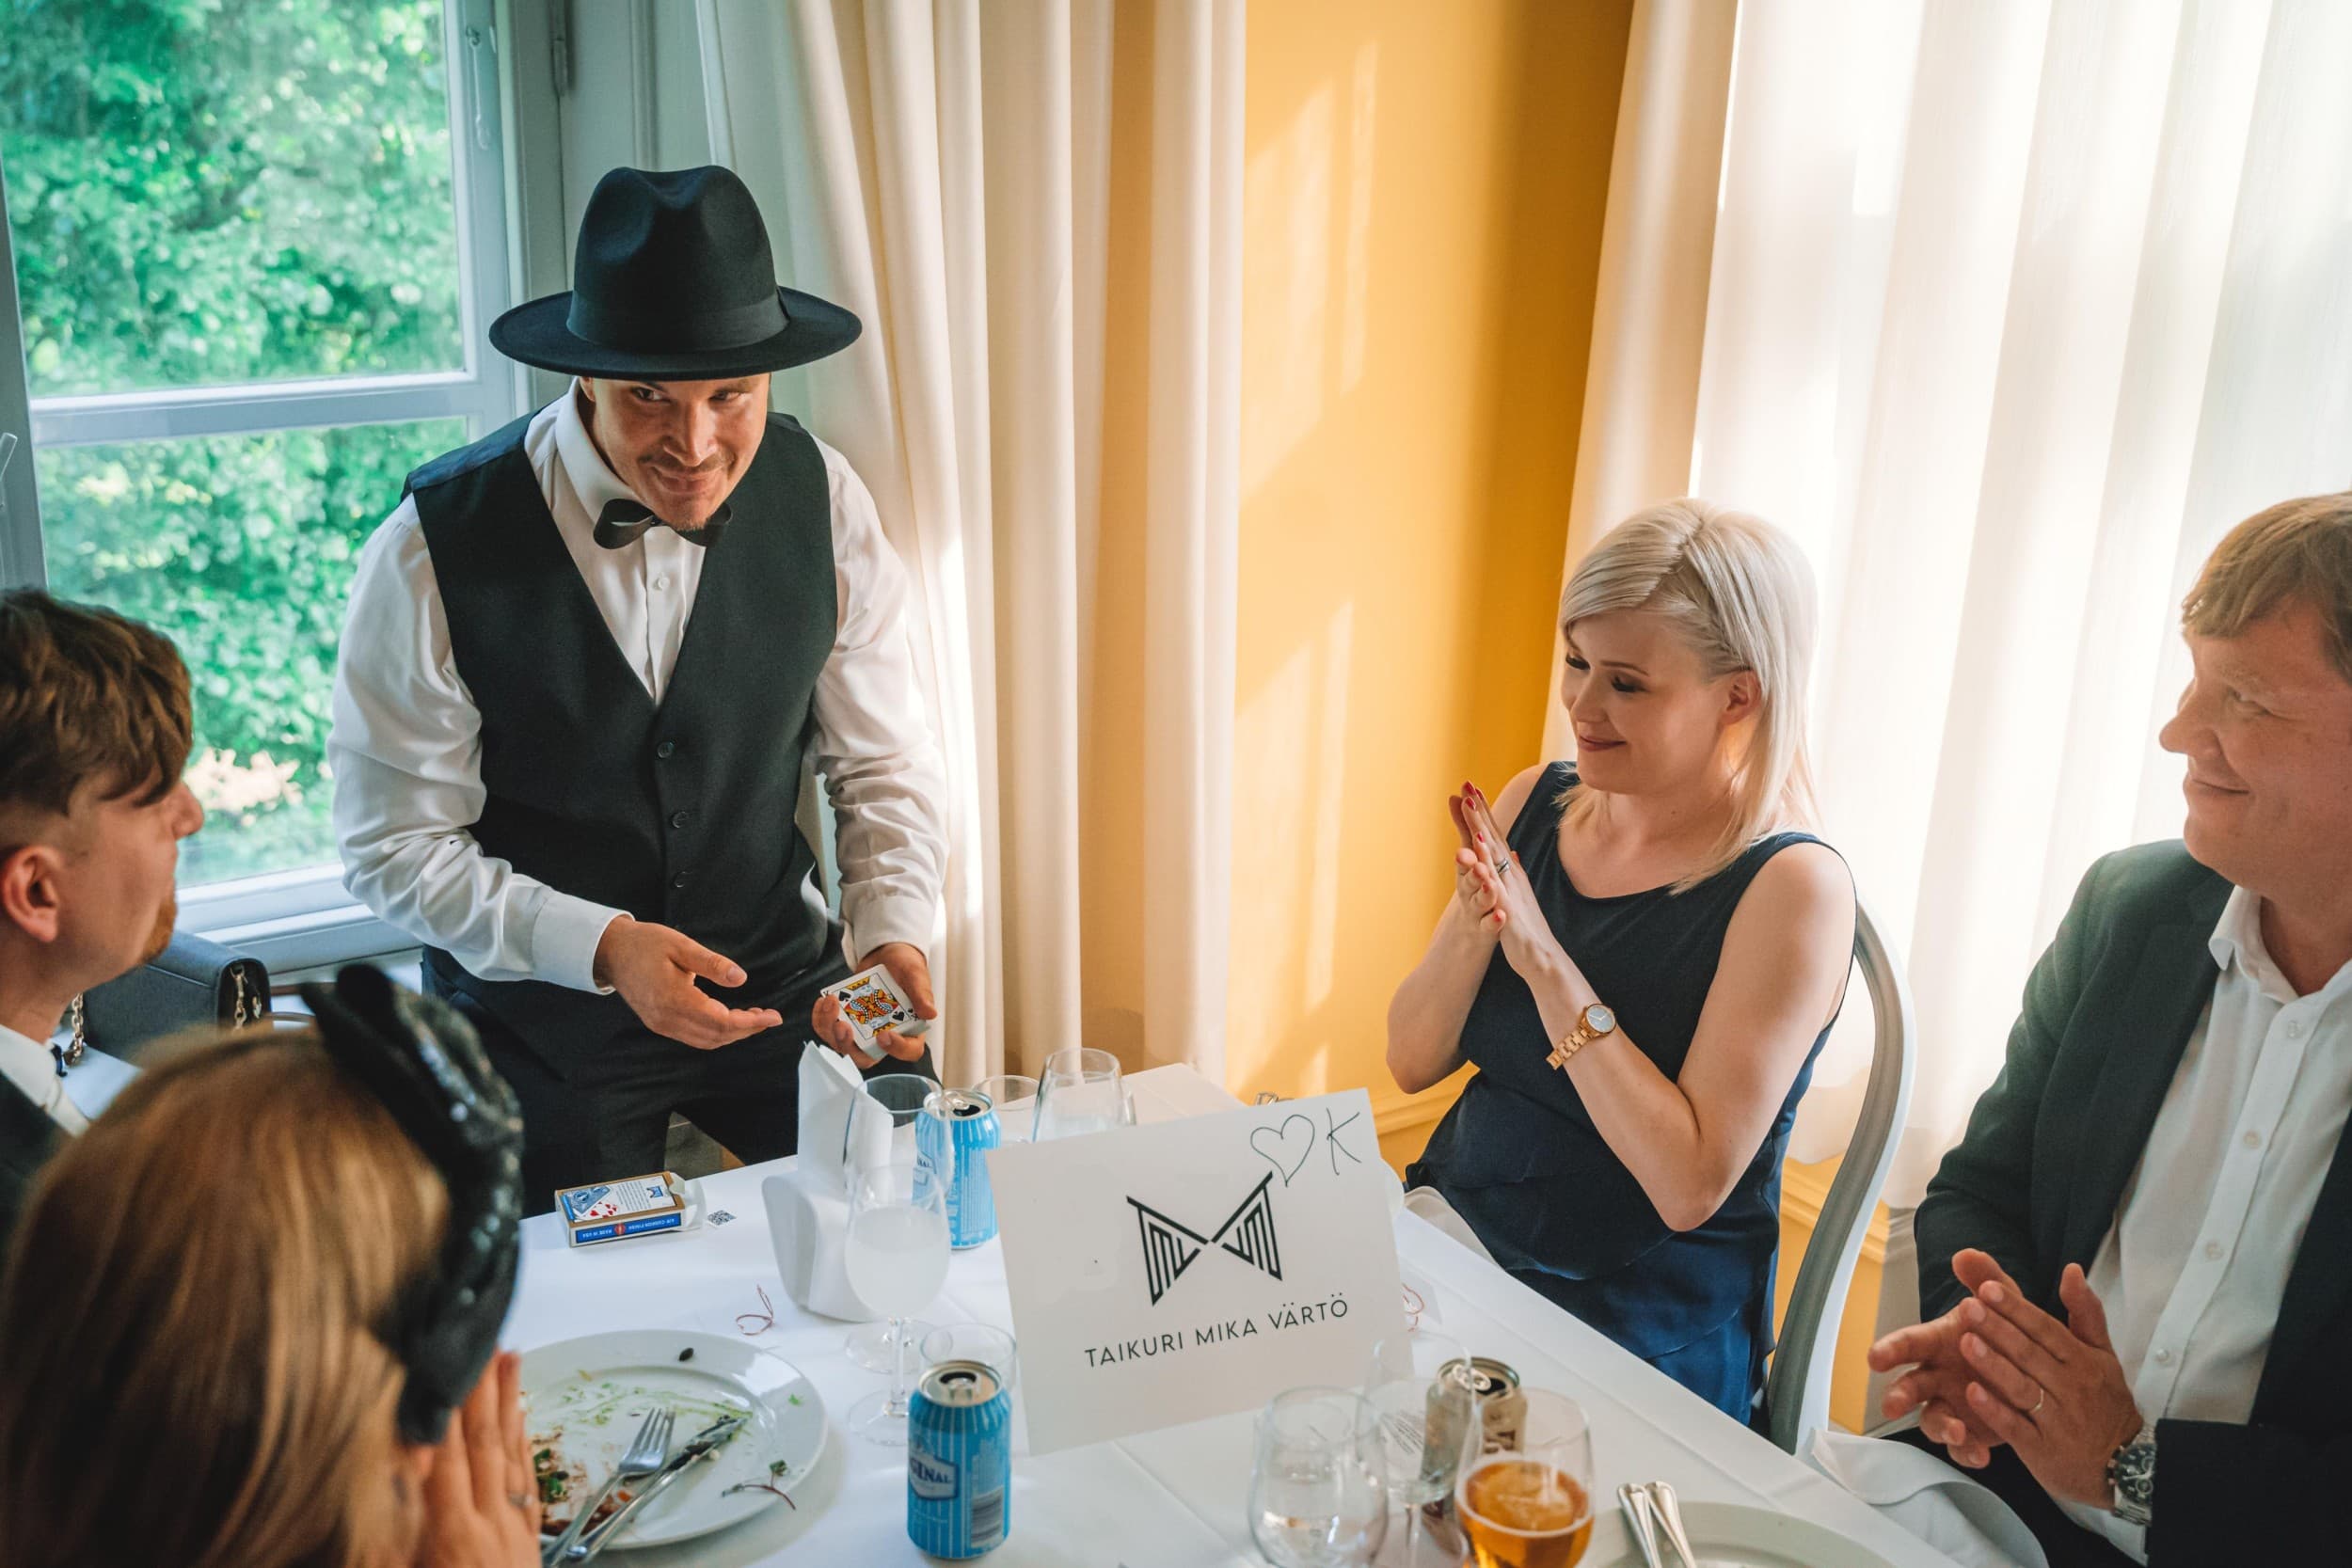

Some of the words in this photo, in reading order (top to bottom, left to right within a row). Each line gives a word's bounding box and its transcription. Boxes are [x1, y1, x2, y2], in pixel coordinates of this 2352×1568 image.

[1326, 1107, 1361, 1176] K
[1084, 1331, 1184, 1368] TAIKURI
[1195, 1318, 1258, 1346] MIKA
[1267, 1291, 1348, 1330] VÄRTÖ
